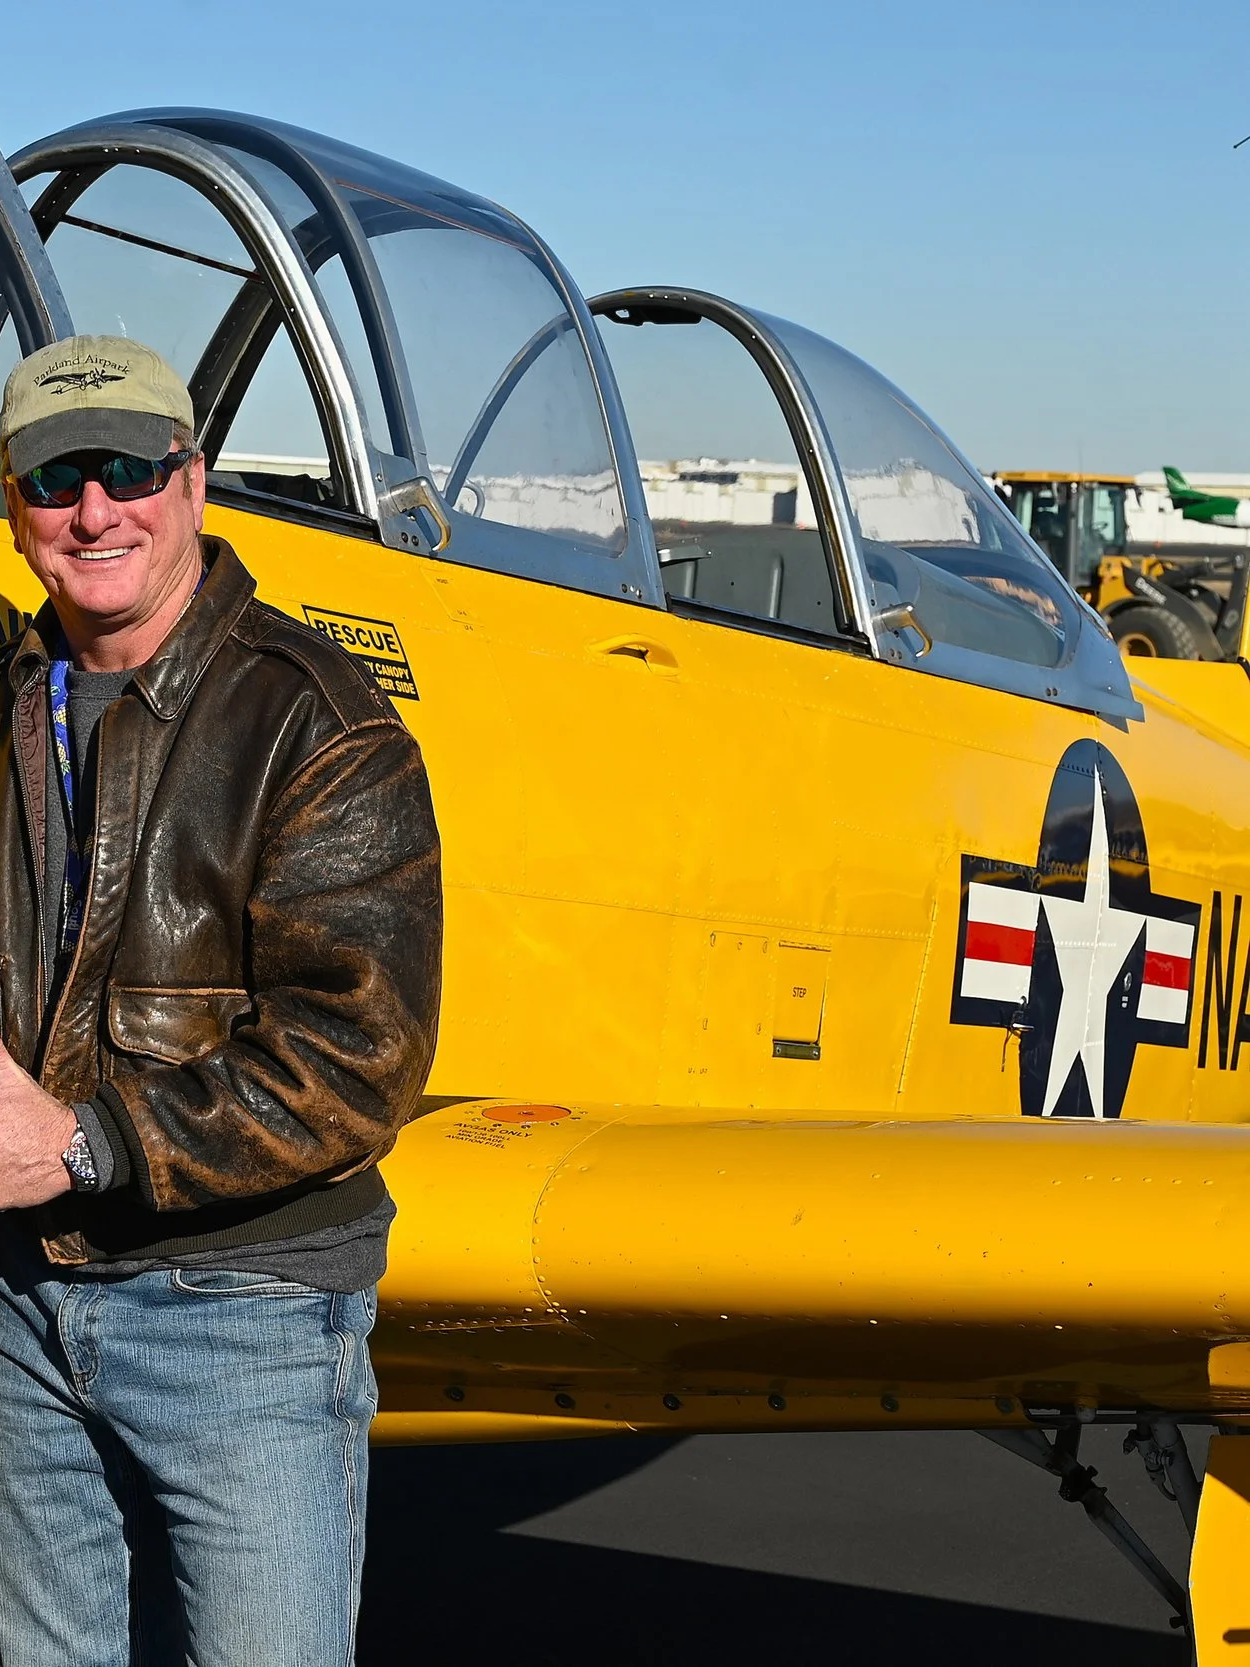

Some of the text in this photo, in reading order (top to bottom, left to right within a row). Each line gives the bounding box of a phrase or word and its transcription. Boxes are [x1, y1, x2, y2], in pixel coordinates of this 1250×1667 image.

[33, 354, 130, 386] Parkland Airpark
[313, 618, 399, 654] RESCUE
[375, 663, 410, 680] CANOPY
[395, 680, 416, 695] SIDE
[793, 986, 807, 998] STEP
[454, 1123, 533, 1138] AVGAS ONLY
[485, 1141, 506, 1149] FUEL
